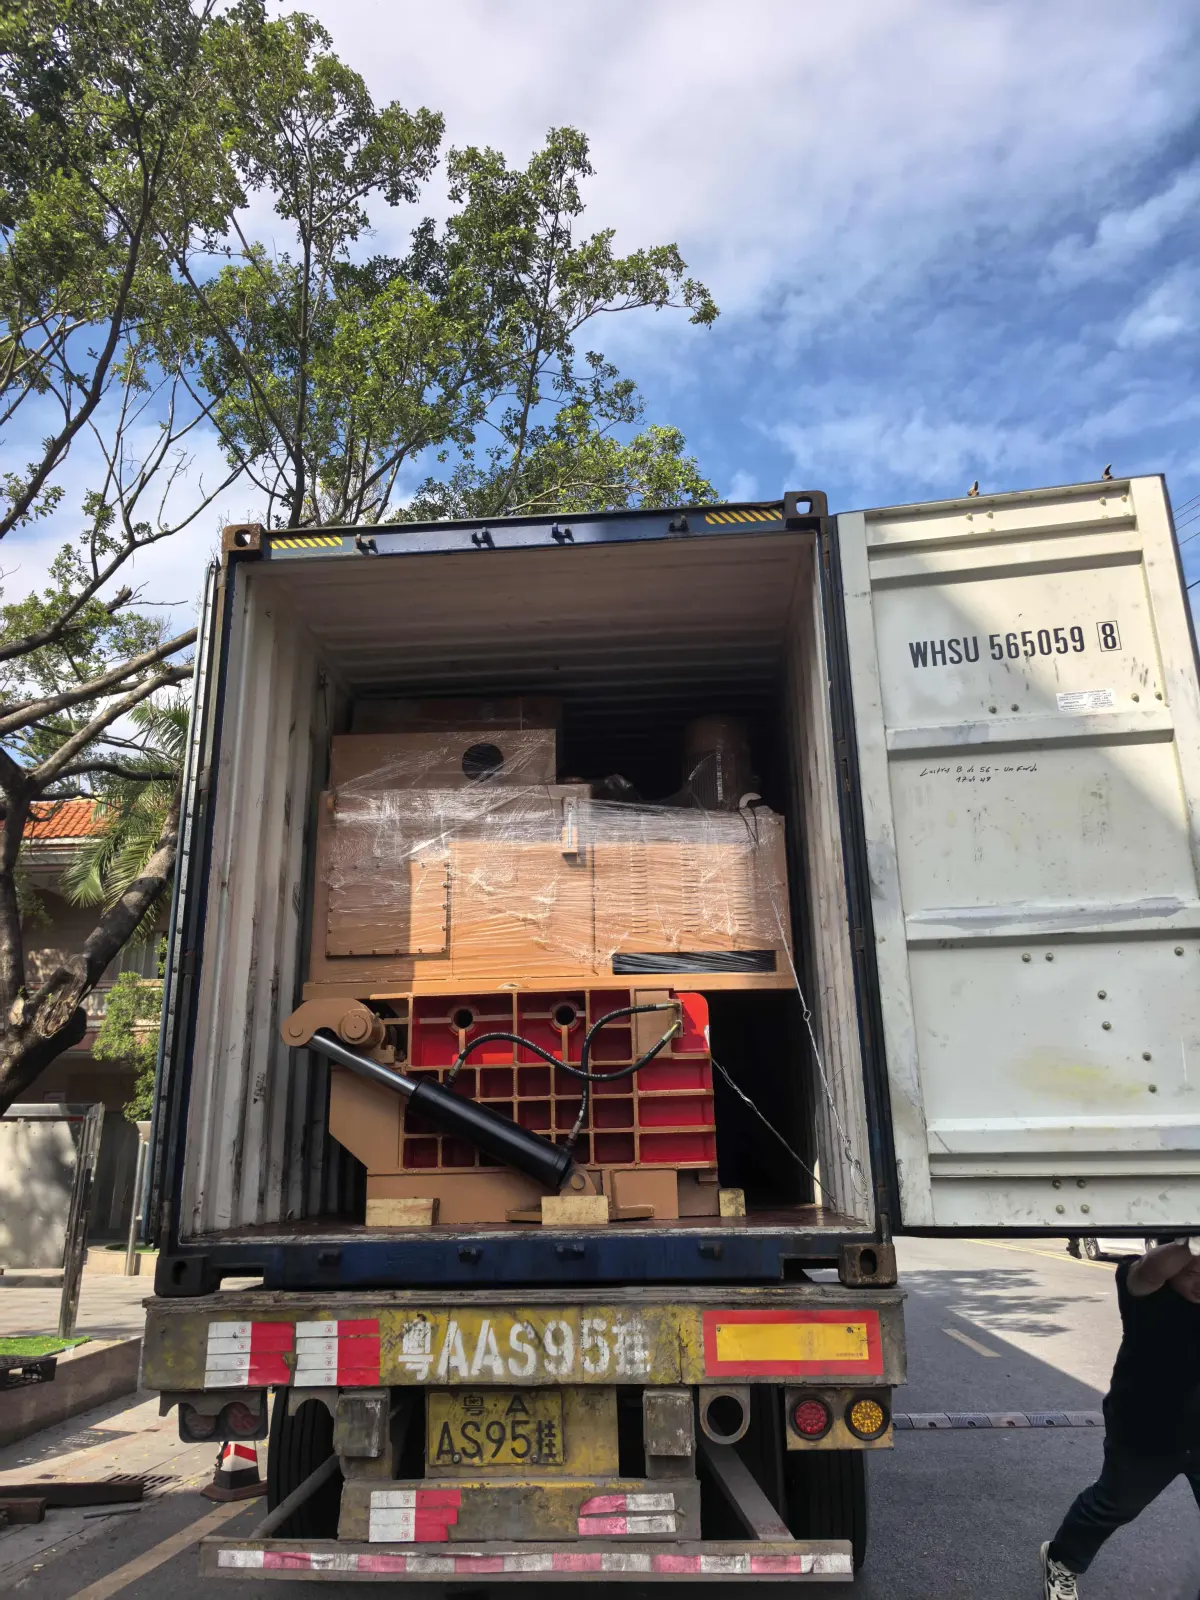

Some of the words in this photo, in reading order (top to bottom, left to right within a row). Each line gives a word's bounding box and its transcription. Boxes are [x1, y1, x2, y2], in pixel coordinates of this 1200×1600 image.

[908, 635, 980, 668] WHSU
[989, 625, 1086, 661] 565059
[1100, 622, 1118, 650] 8
[436, 1420, 557, 1463] AS95挂
